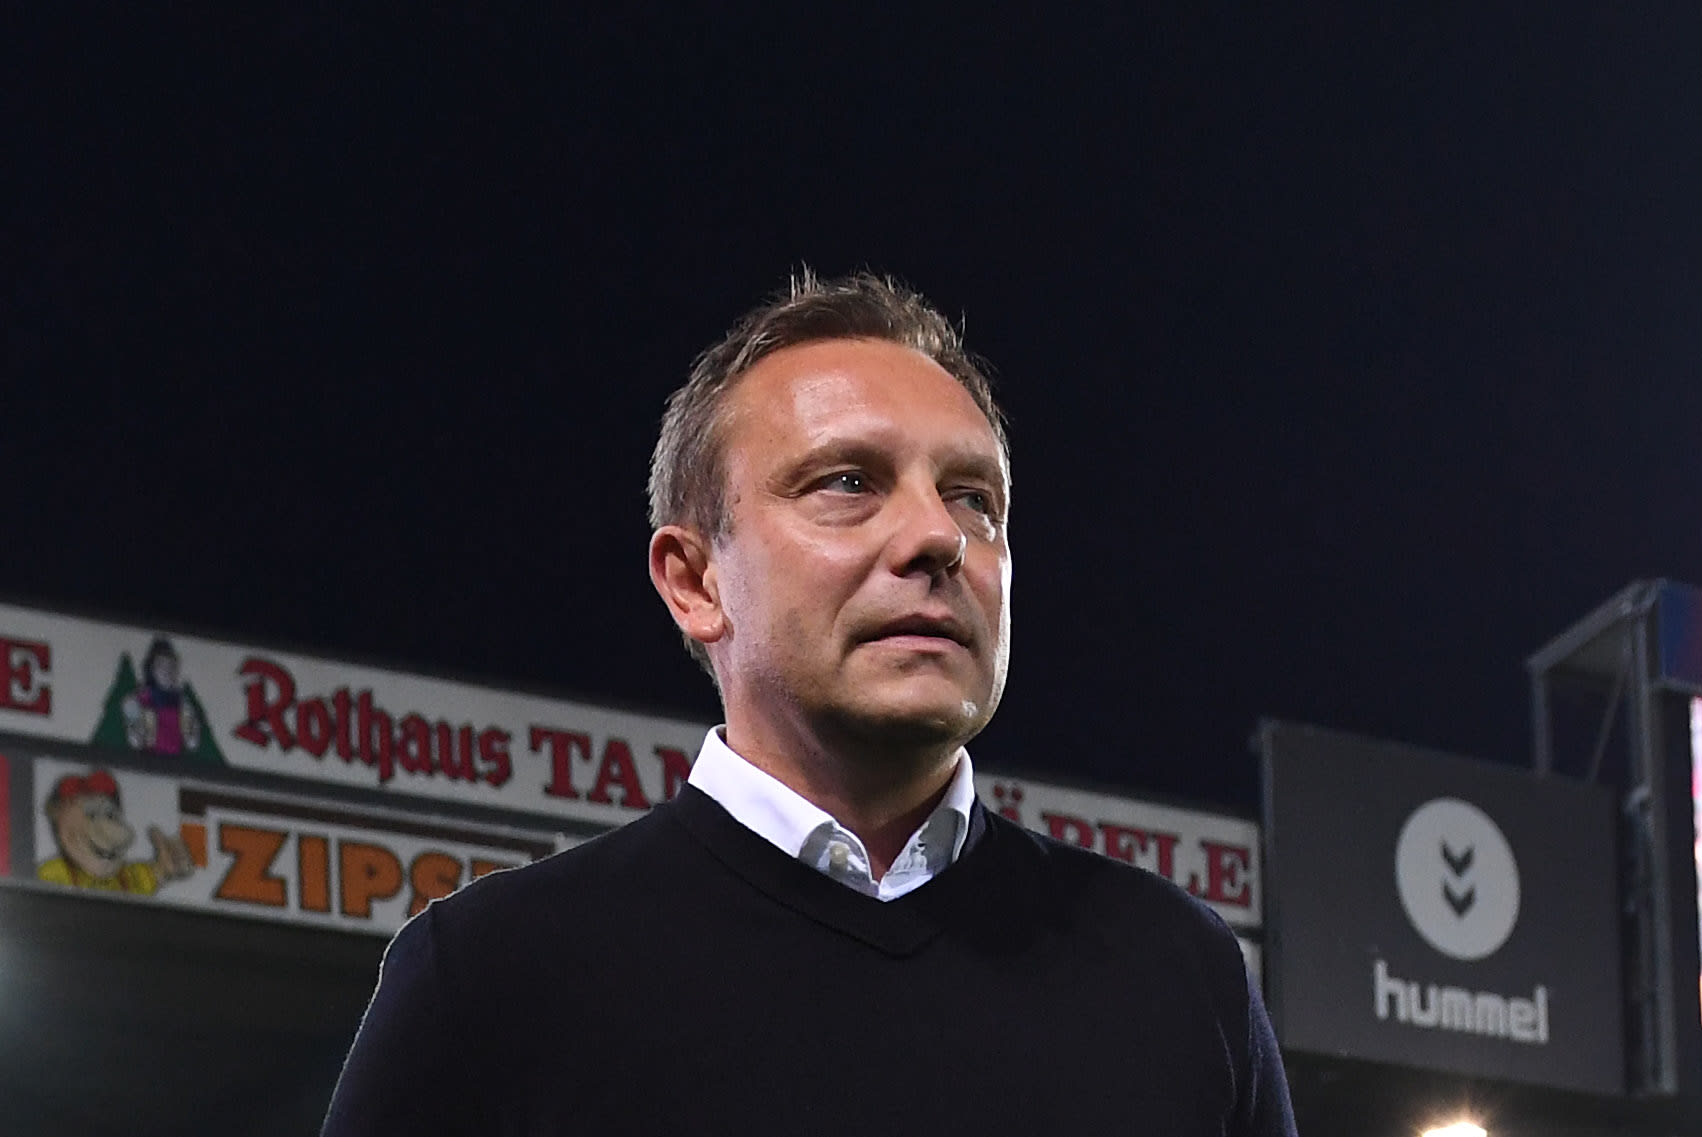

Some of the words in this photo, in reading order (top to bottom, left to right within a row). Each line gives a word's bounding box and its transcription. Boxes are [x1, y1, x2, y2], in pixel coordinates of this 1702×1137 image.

[234, 655, 513, 788] Rothaus
[212, 823, 503, 918] ZIPS
[1373, 958, 1550, 1045] hummel
